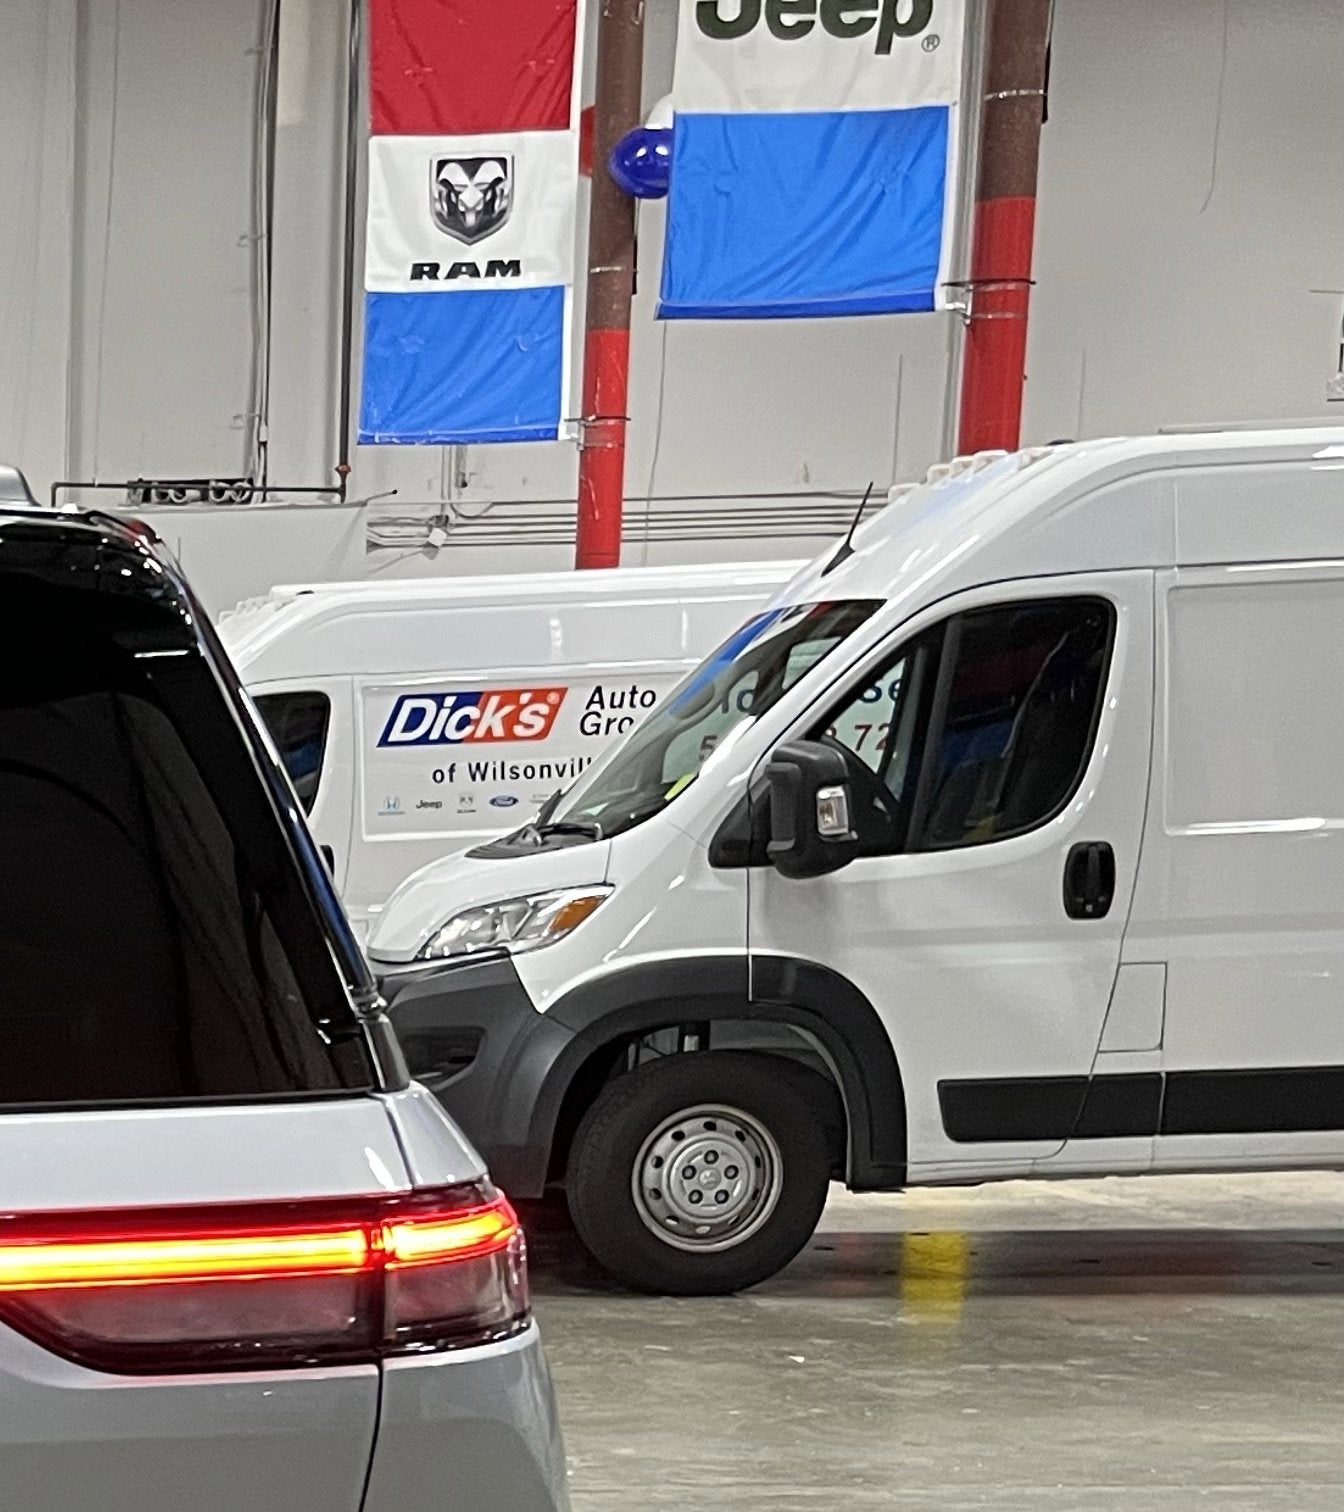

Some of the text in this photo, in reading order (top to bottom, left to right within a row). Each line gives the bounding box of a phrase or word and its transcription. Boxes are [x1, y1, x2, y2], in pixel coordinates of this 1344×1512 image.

[410, 260, 521, 281] RAM
[585, 685, 657, 710] Auto
[387, 692, 550, 743] Dick's
[579, 711, 635, 736] Gro
[432, 762, 457, 784] of
